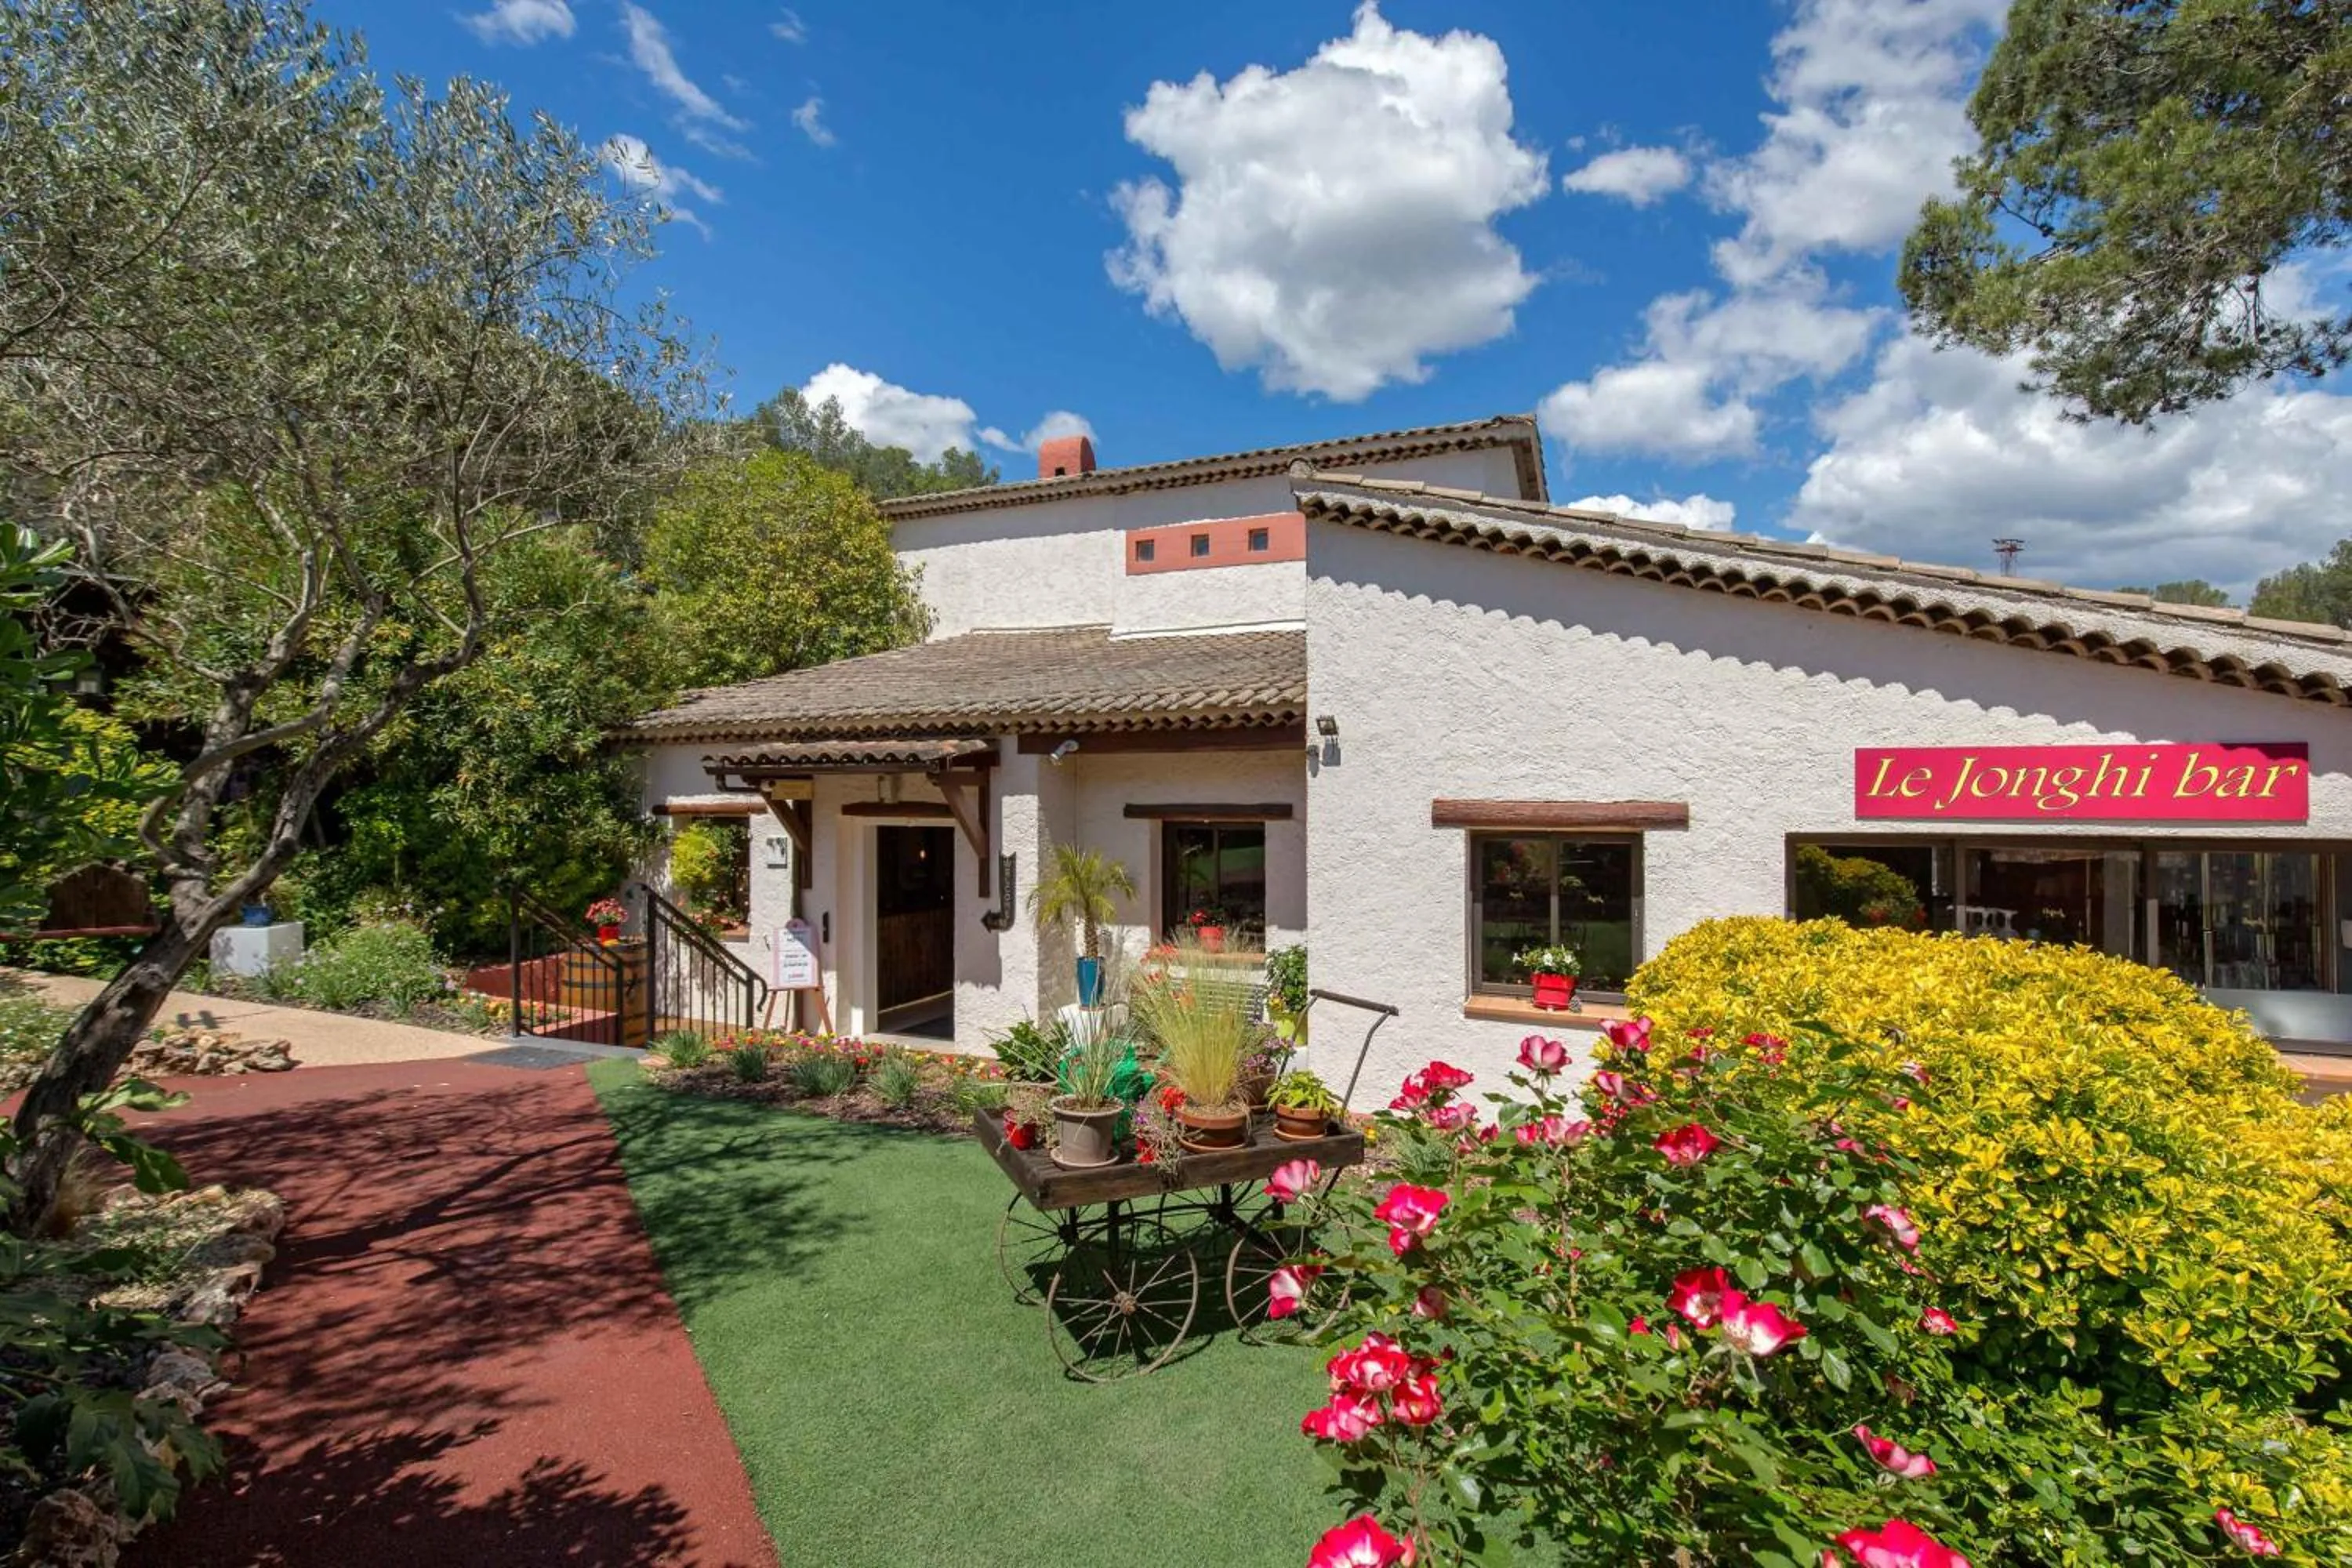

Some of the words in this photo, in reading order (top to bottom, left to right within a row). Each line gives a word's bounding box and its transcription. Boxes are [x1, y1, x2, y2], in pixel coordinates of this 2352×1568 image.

[1867, 758, 1931, 797] Le
[1935, 753, 2158, 810] Jonghi
[2172, 753, 2298, 797] bar
